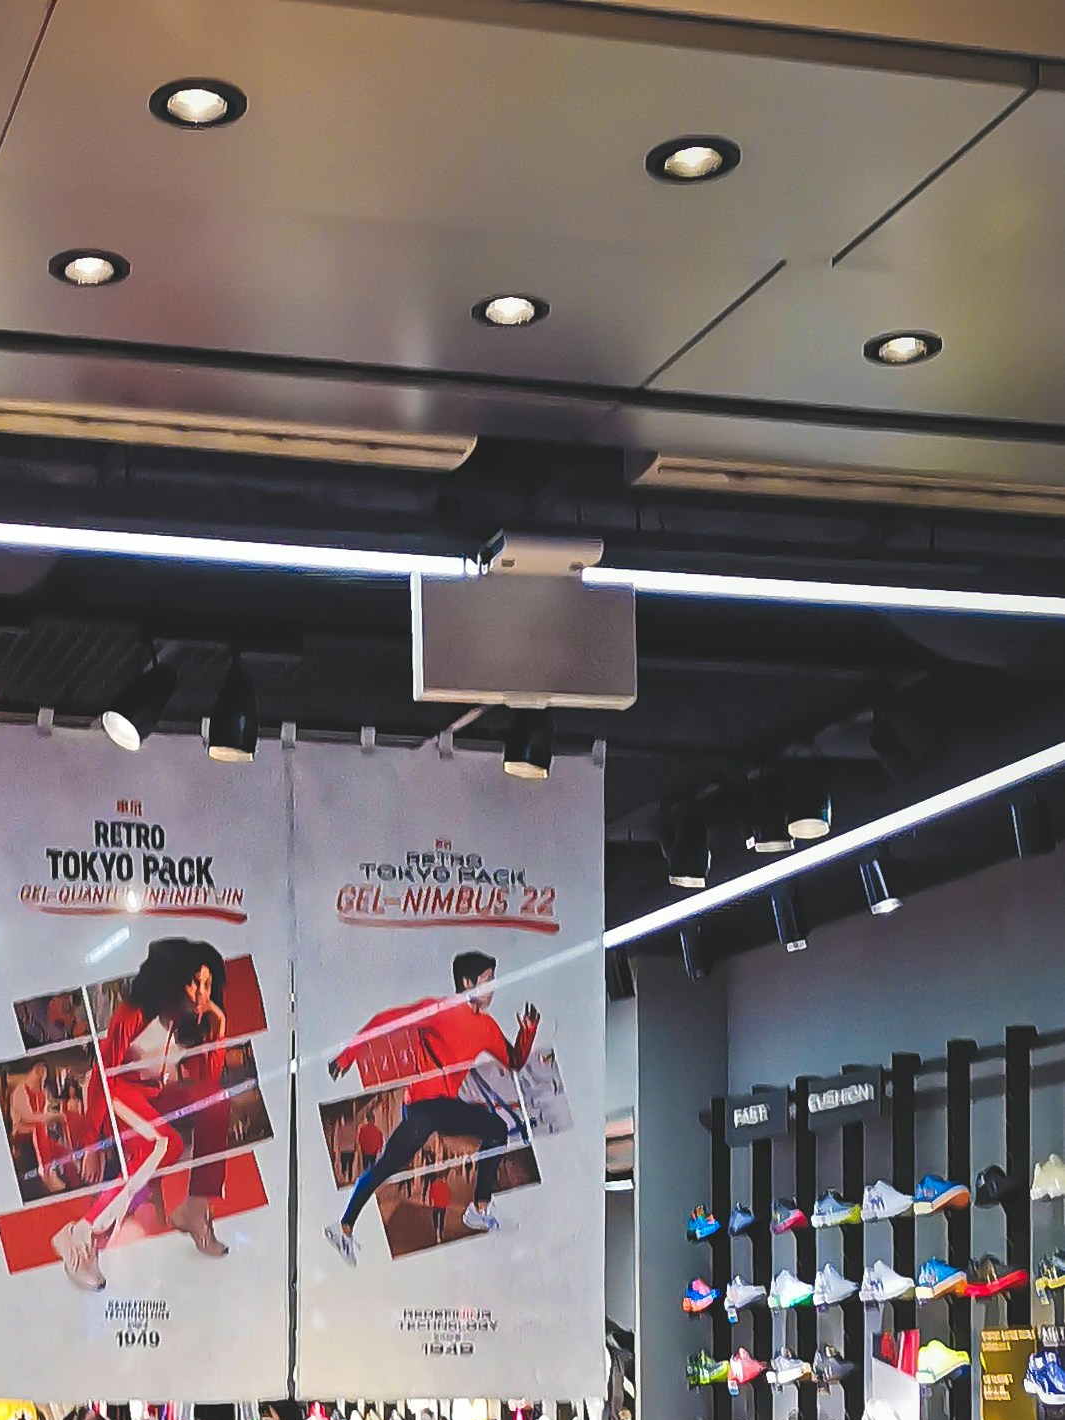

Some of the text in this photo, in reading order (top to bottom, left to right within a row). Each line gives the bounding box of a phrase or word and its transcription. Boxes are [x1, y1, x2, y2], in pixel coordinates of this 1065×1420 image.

[94, 820, 165, 850] RETRO
[46, 848, 133, 883] TOKYO
[360, 863, 451, 883] TOKYO
[337, 885, 556, 917] GEL-NIMBUS 22
[116, 1330, 161, 1348] 1949
